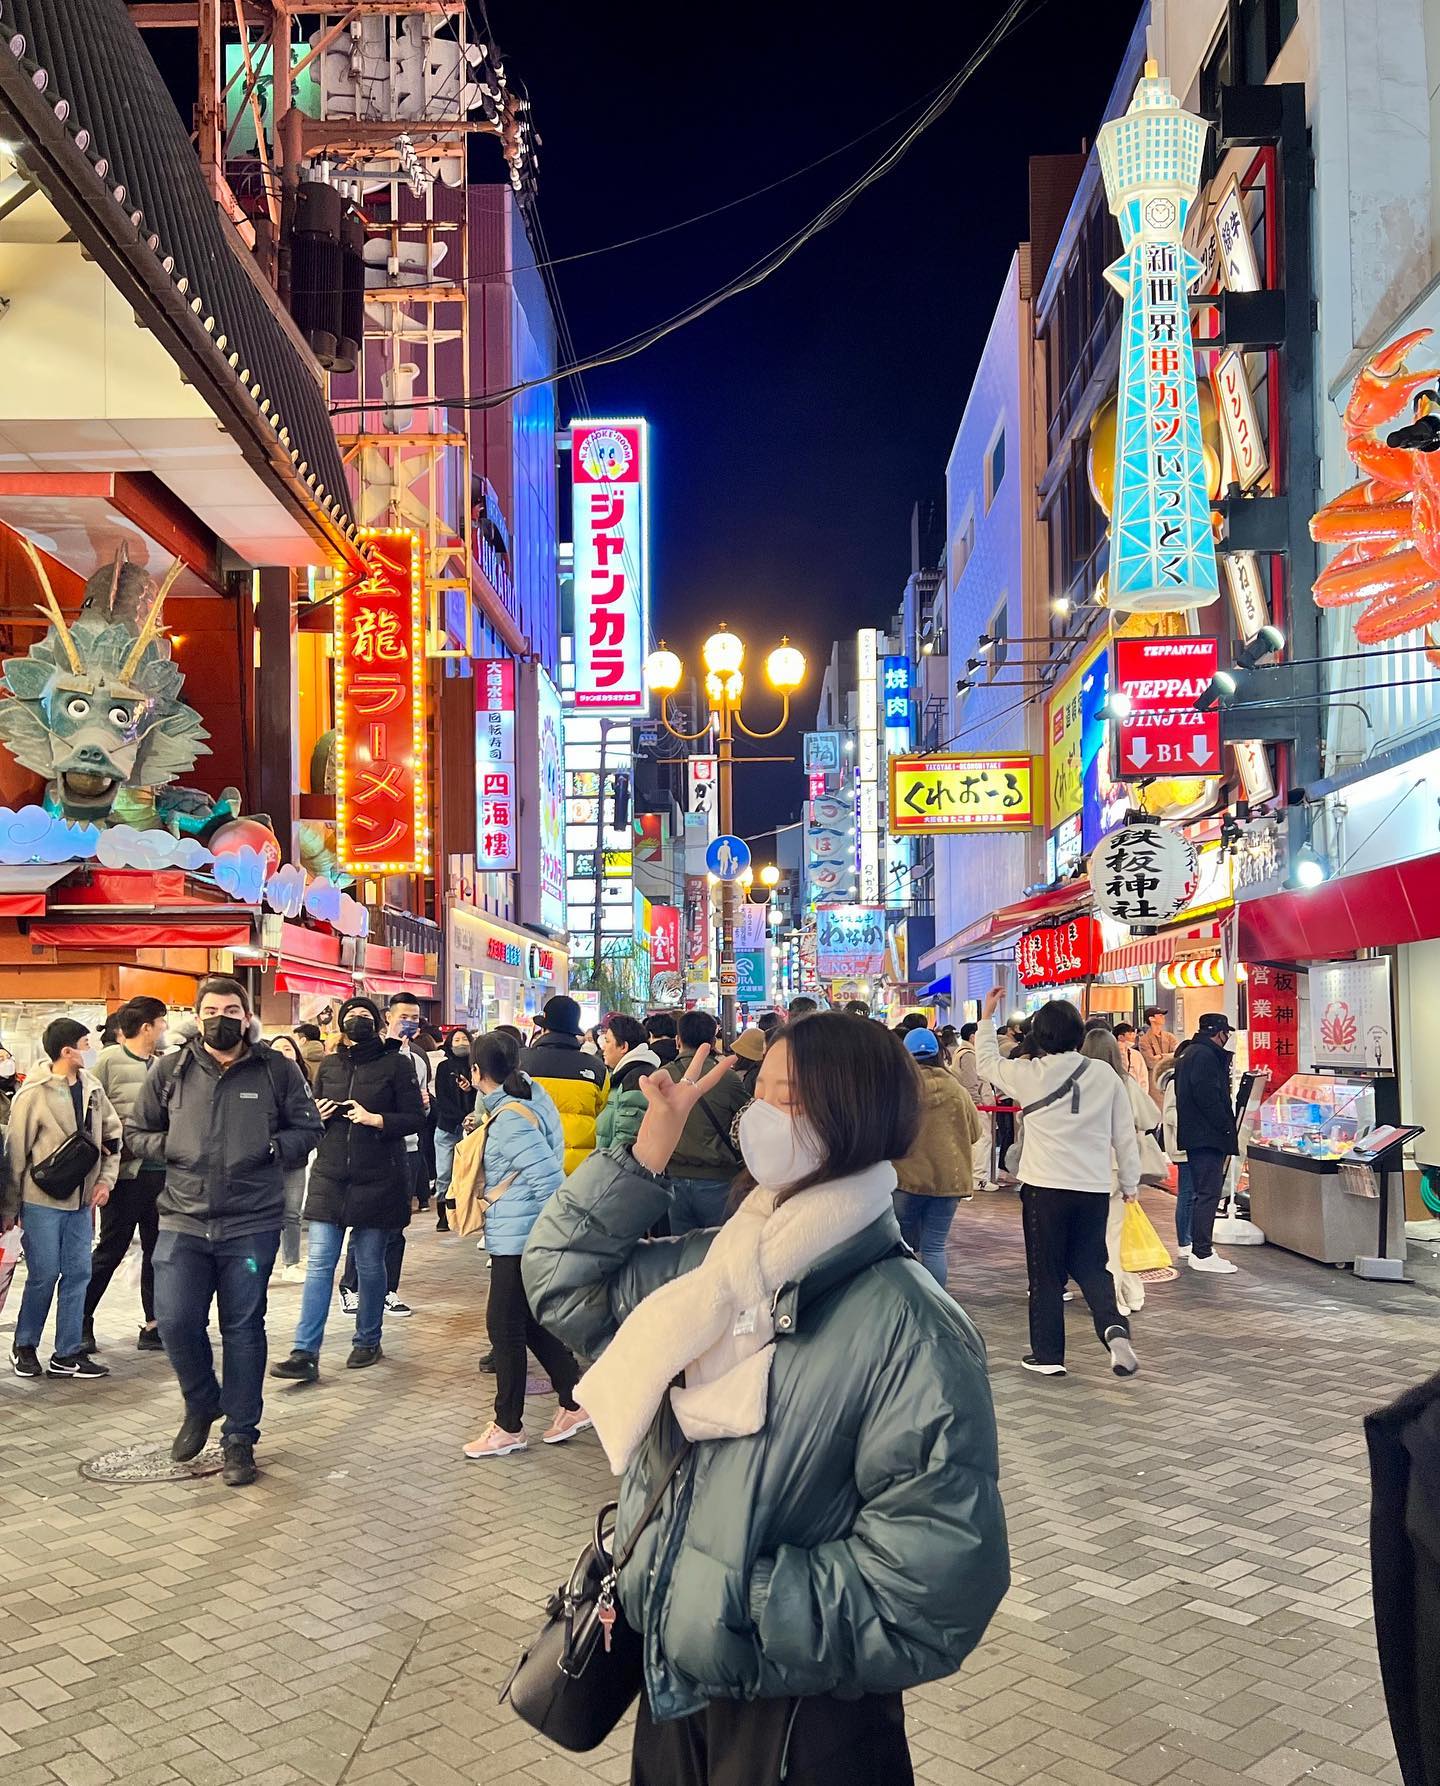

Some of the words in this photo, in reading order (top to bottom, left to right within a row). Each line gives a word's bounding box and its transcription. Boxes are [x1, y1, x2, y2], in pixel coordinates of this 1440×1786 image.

[1148, 244, 1183, 585] 新世界串カツいっとく
[590, 489, 625, 688] ジャンカラ
[1144, 644, 1213, 656] TEPPANYAKI
[348, 540, 408, 857] 金龍ラーメン
[885, 668, 908, 717] 焼肉
[1123, 678, 1212, 698] TEPPAN
[488, 712, 502, 760] 回転寿司
[1123, 707, 1205, 727] JINJYA
[1157, 744, 1183, 762] B1
[1105, 829, 1166, 919] 鉄板神社
[820, 922, 884, 947] わなか
